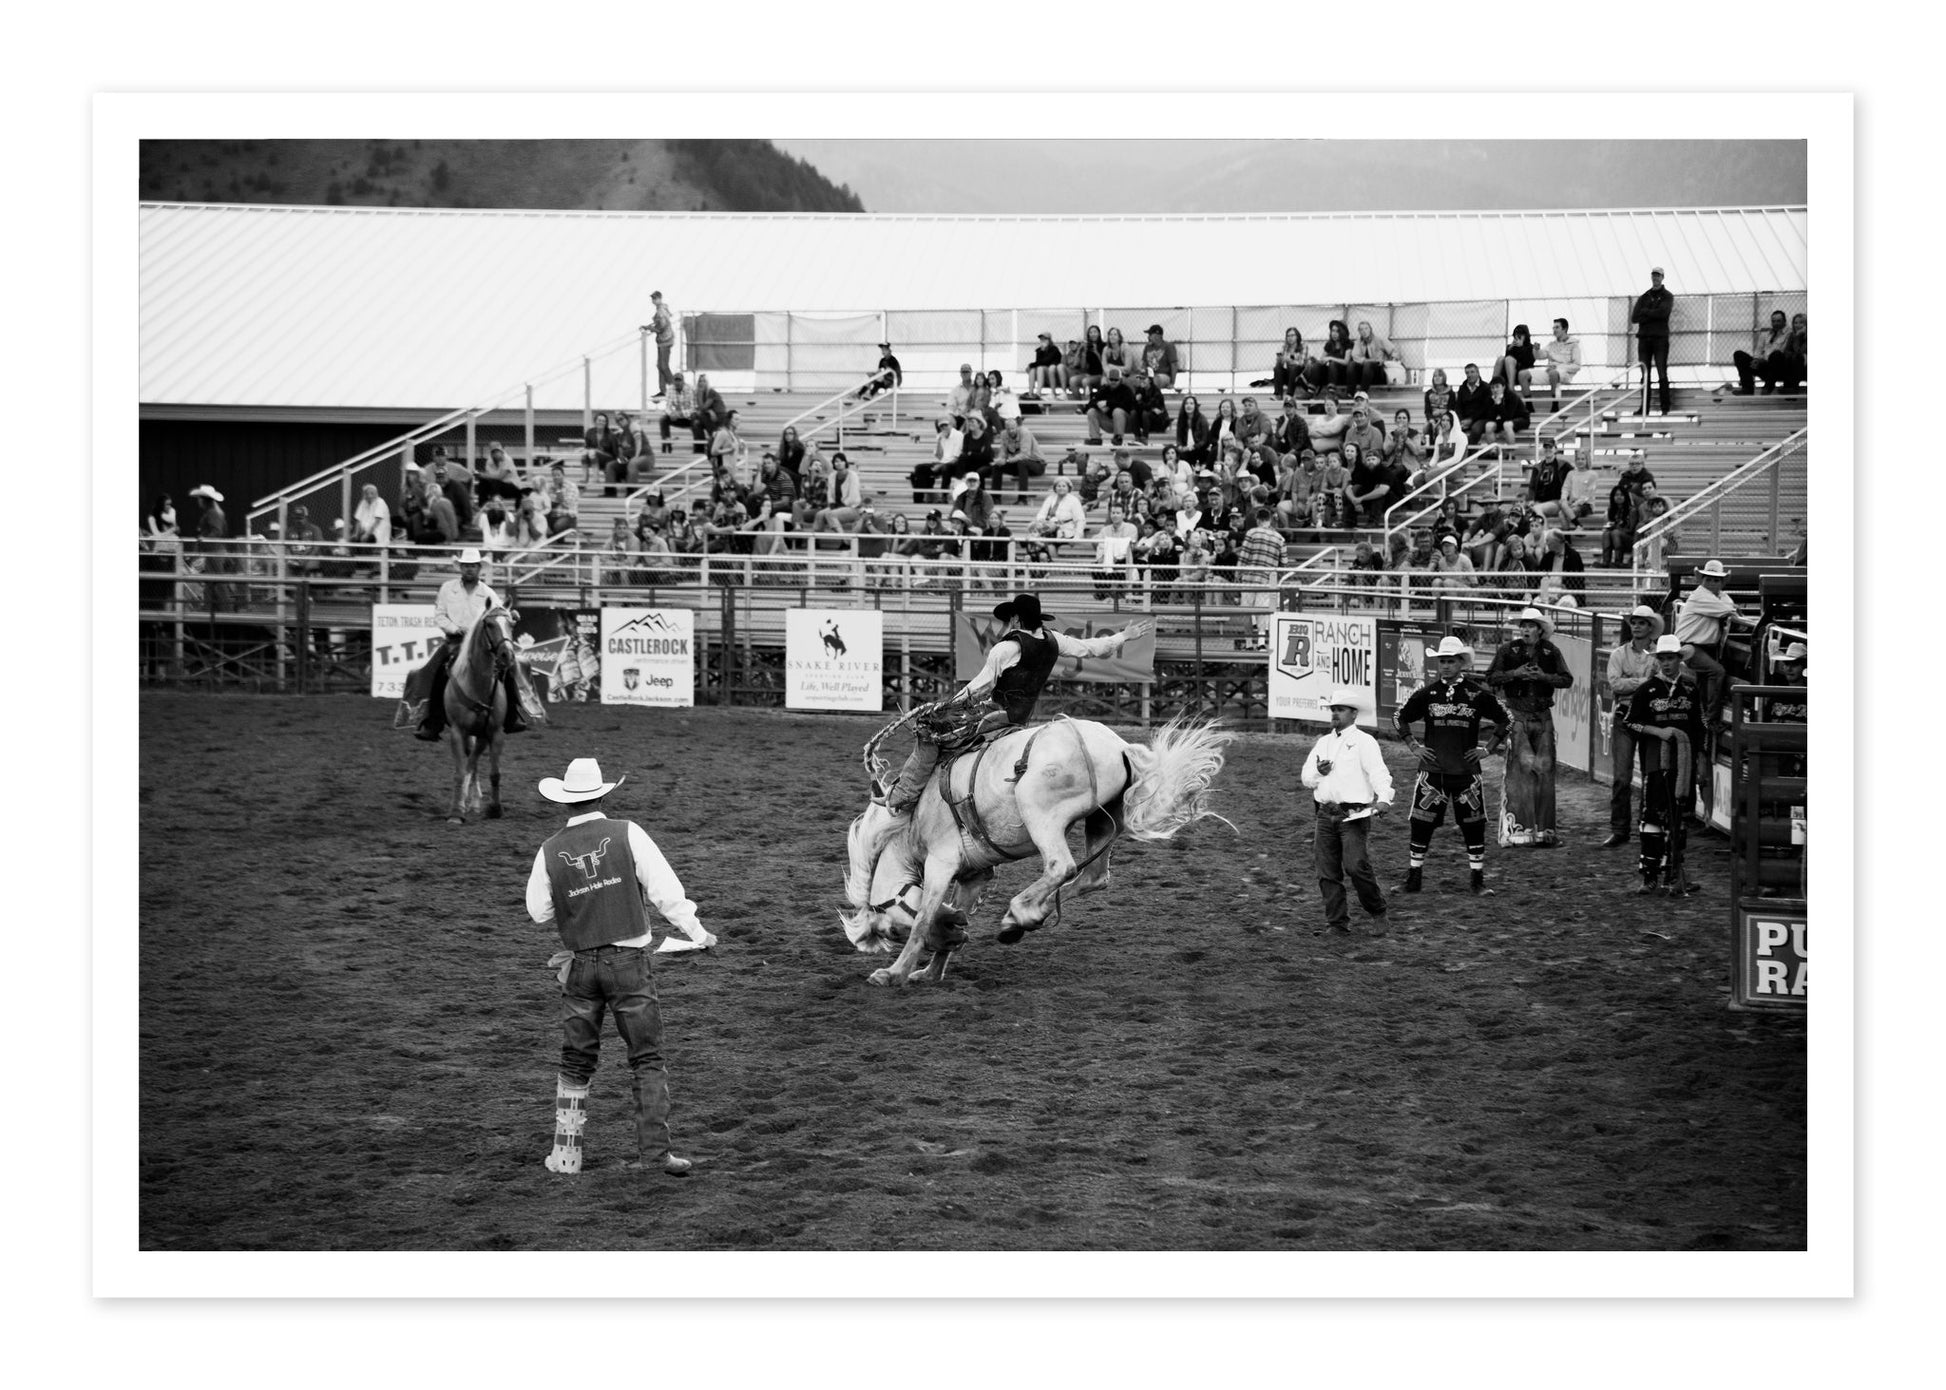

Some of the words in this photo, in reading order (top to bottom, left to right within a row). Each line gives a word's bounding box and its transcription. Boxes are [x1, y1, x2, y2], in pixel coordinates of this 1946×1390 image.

[1288, 624, 1309, 635] BIG
[1315, 621, 1371, 646] RANCH
[608, 638, 688, 655] CASTLEROCK
[1282, 635, 1310, 667] R
[787, 661, 832, 671] SNAKE
[838, 662, 880, 672] RIVER
[1316, 655, 1330, 668] AND
[1333, 647, 1371, 686] HOME
[645, 674, 674, 689] Jeep
[800, 681, 819, 692] Life,
[821, 682, 840, 692] Well
[841, 682, 870, 693] Played
[568, 887, 590, 897] Jackson
[590, 881, 603, 890] Hole
[603, 877, 621, 886] Rodeo
